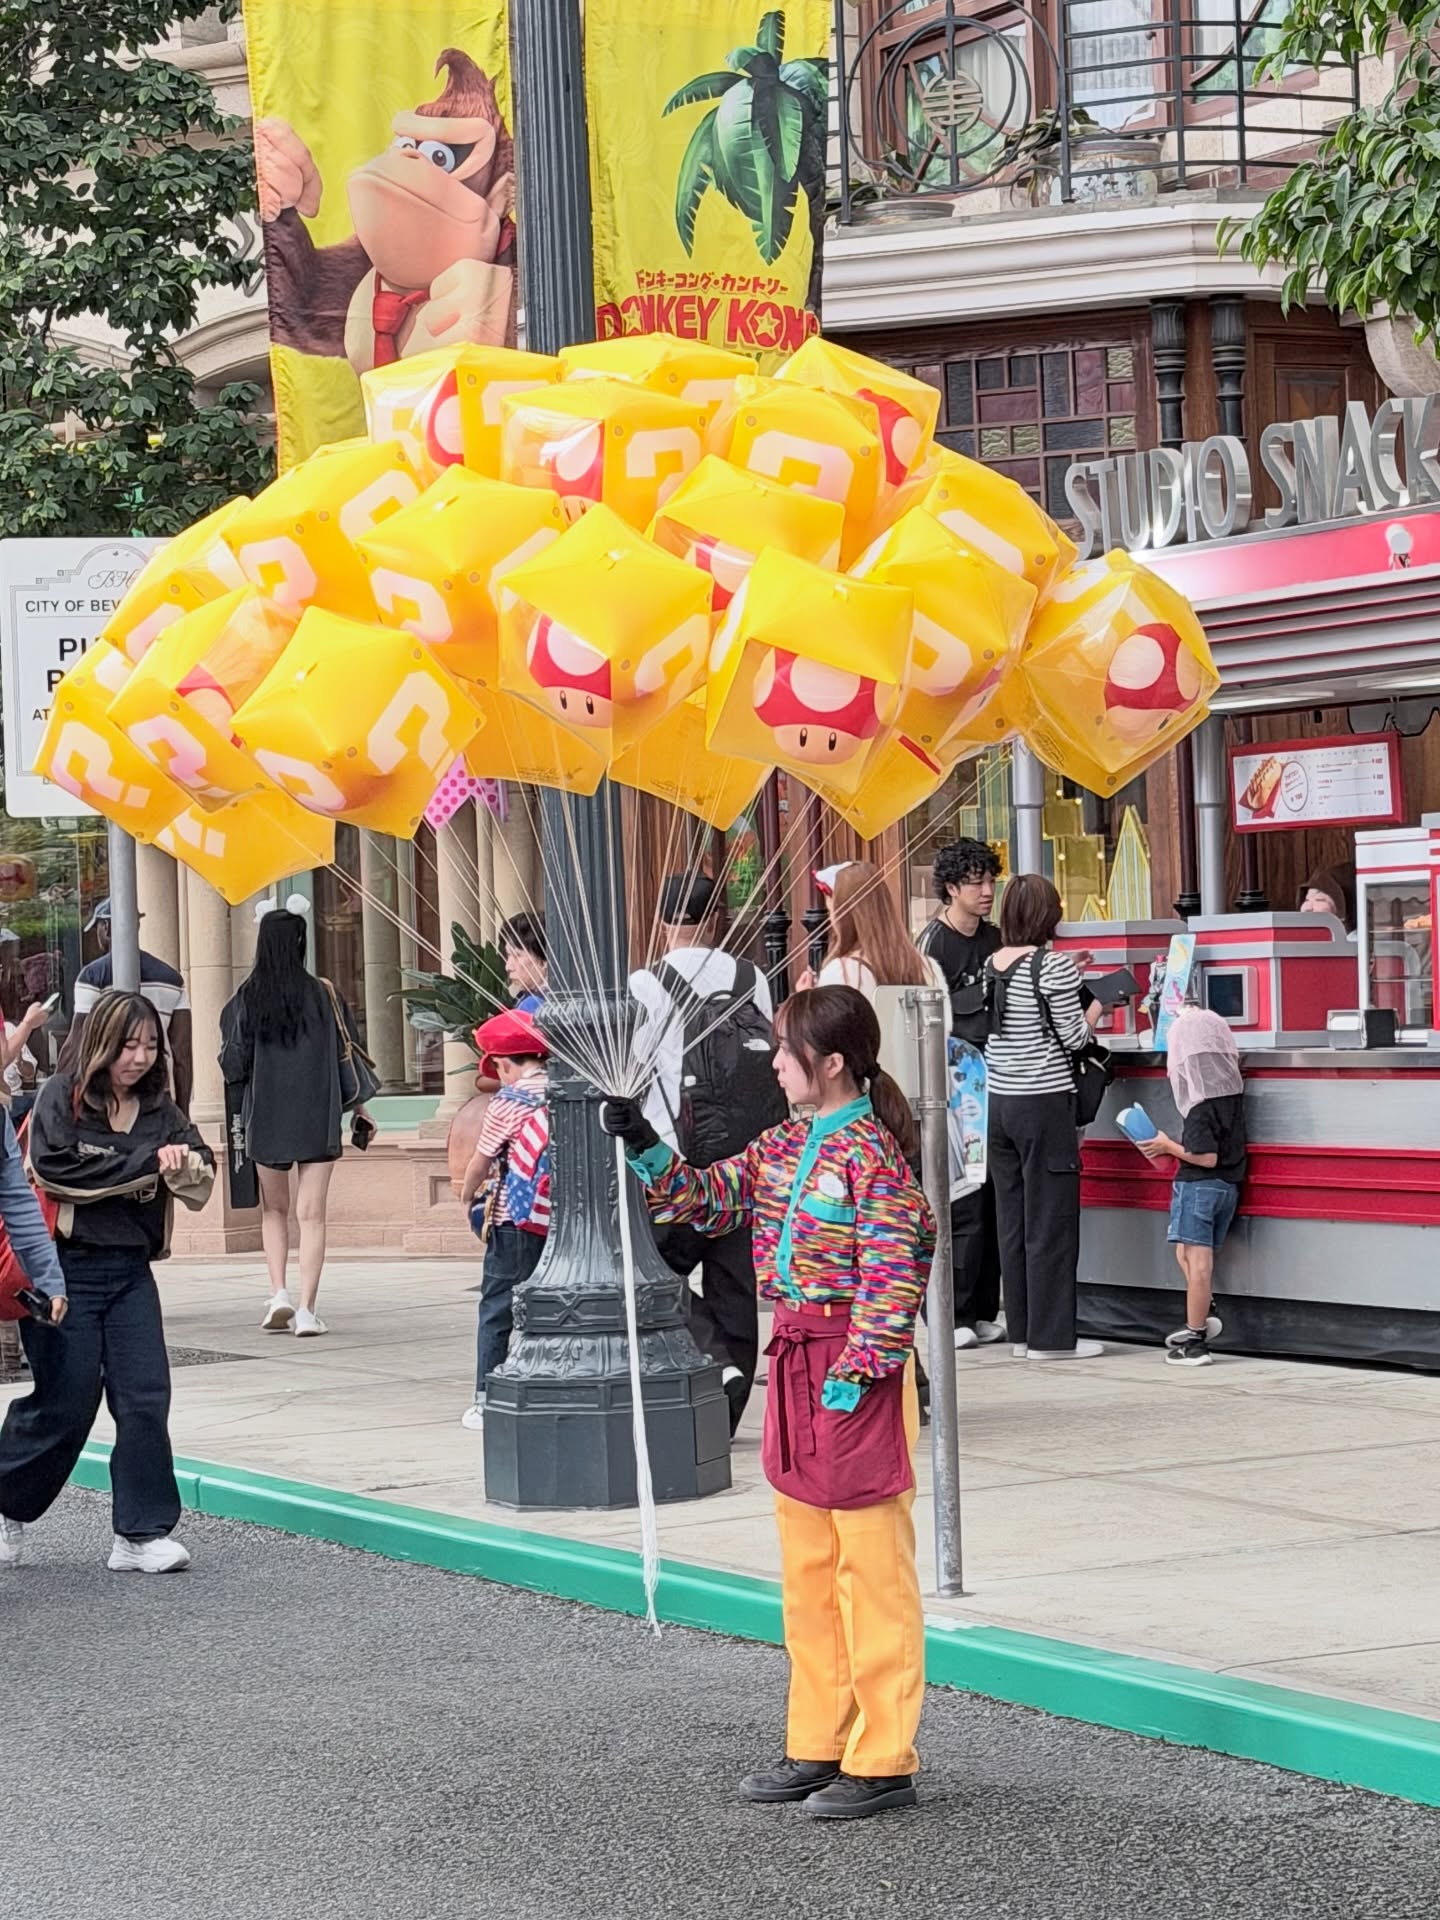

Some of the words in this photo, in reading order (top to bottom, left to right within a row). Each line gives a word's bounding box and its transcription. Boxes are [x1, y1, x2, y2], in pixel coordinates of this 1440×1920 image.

[596, 294, 720, 341] DONKEY
[1064, 435, 1252, 560] STUDIO
[25, 600, 59, 613] CITY
[64, 600, 85, 612] OF
